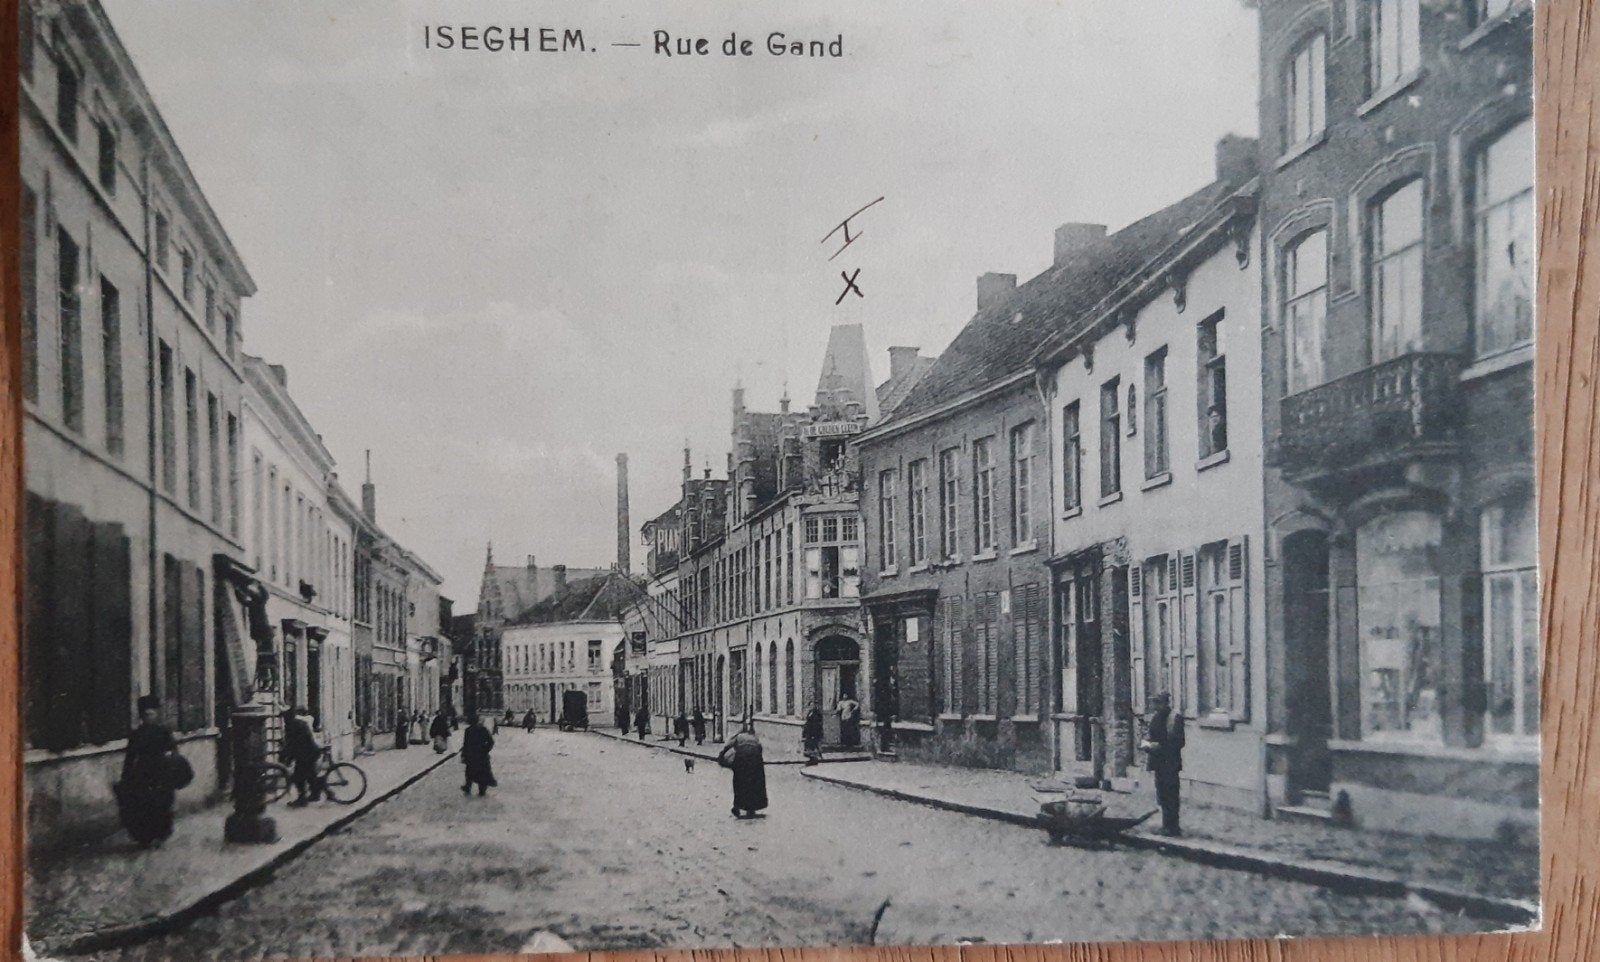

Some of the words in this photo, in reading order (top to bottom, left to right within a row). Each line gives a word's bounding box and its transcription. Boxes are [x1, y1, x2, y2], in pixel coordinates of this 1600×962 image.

[425, 25, 597, 53] ISEGHEM.
[653, 30, 709, 57] Rue
[722, 31, 753, 57] de
[766, 32, 843, 58] Gand
